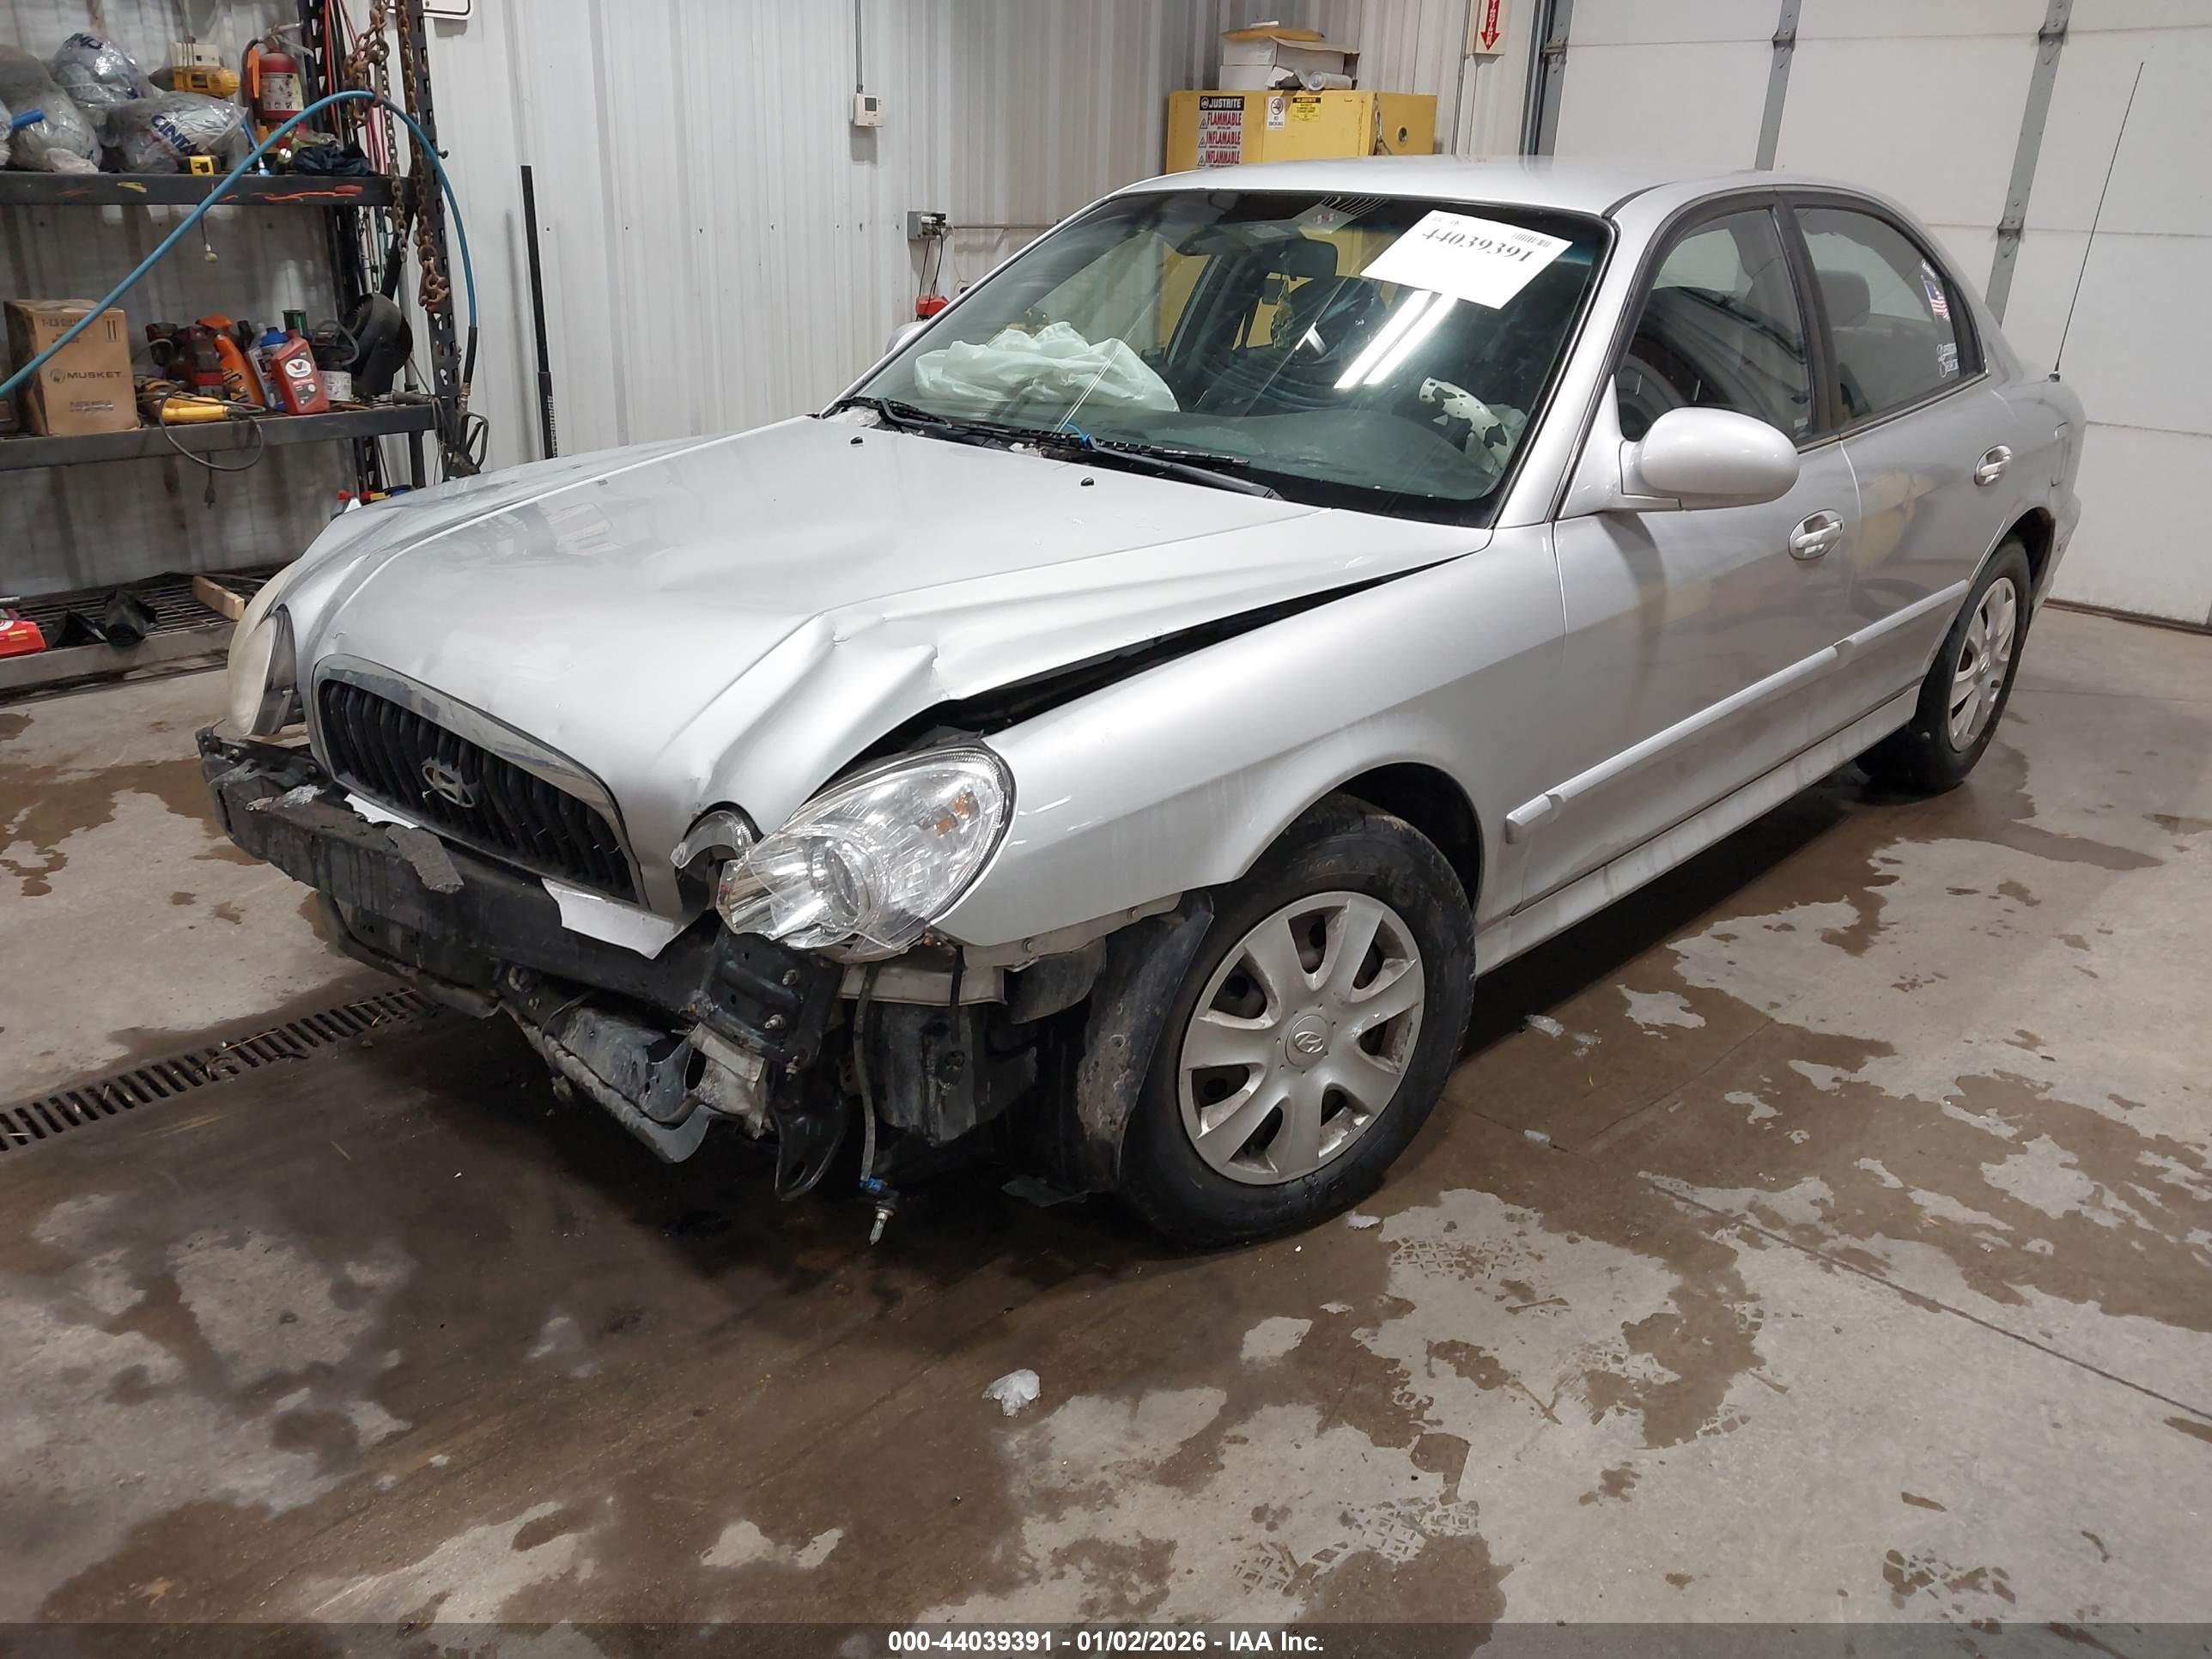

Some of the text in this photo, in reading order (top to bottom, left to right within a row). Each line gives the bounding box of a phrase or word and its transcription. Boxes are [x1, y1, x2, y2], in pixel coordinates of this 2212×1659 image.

[1209, 98, 1242, 109] JUSTRITE
[1207, 112, 1242, 126] FLAMMABLE
[1206, 131, 1241, 145] INFLAMABLE
[1206, 150, 1240, 164] INFLAMMABLE
[1422, 228, 1534, 262] 44039391
